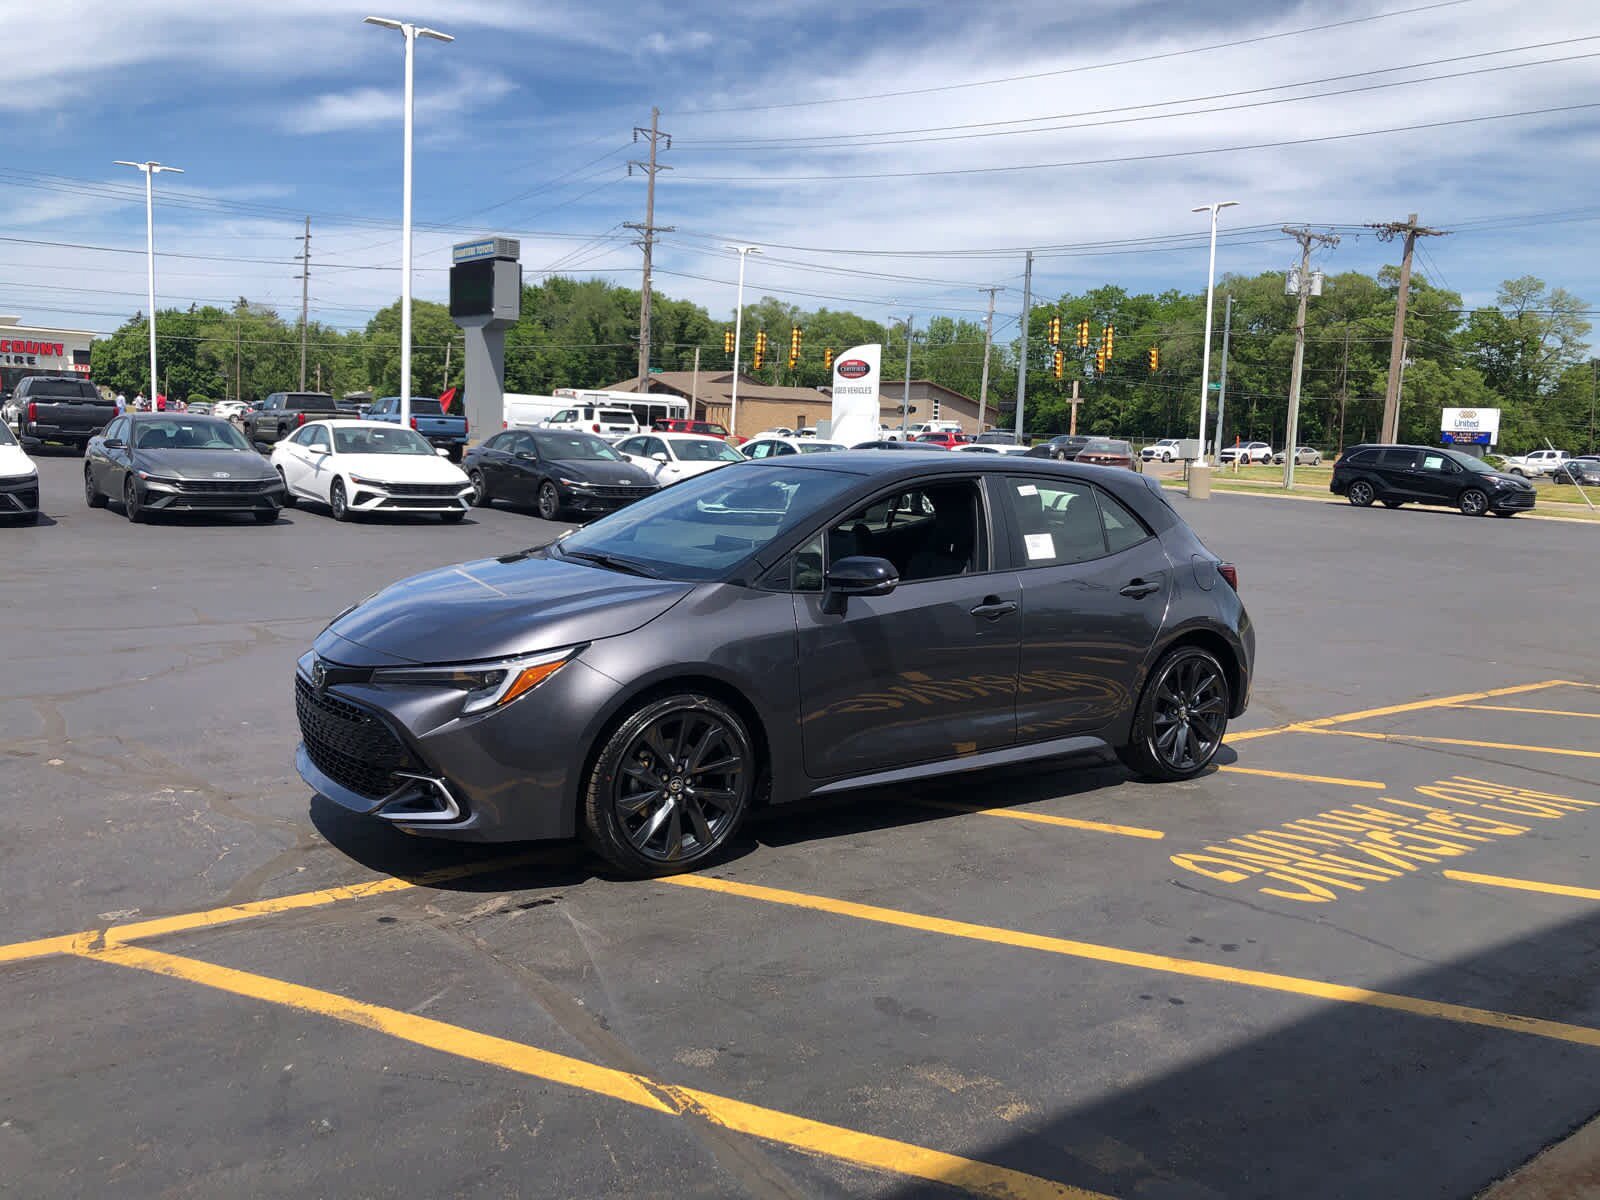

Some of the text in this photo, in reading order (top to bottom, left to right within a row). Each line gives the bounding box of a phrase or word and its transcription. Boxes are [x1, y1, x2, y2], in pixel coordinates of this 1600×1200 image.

[847, 386, 872, 394] VEHICLES
[1454, 419, 1480, 428] United
[1170, 775, 1600, 902] NO PARKING
